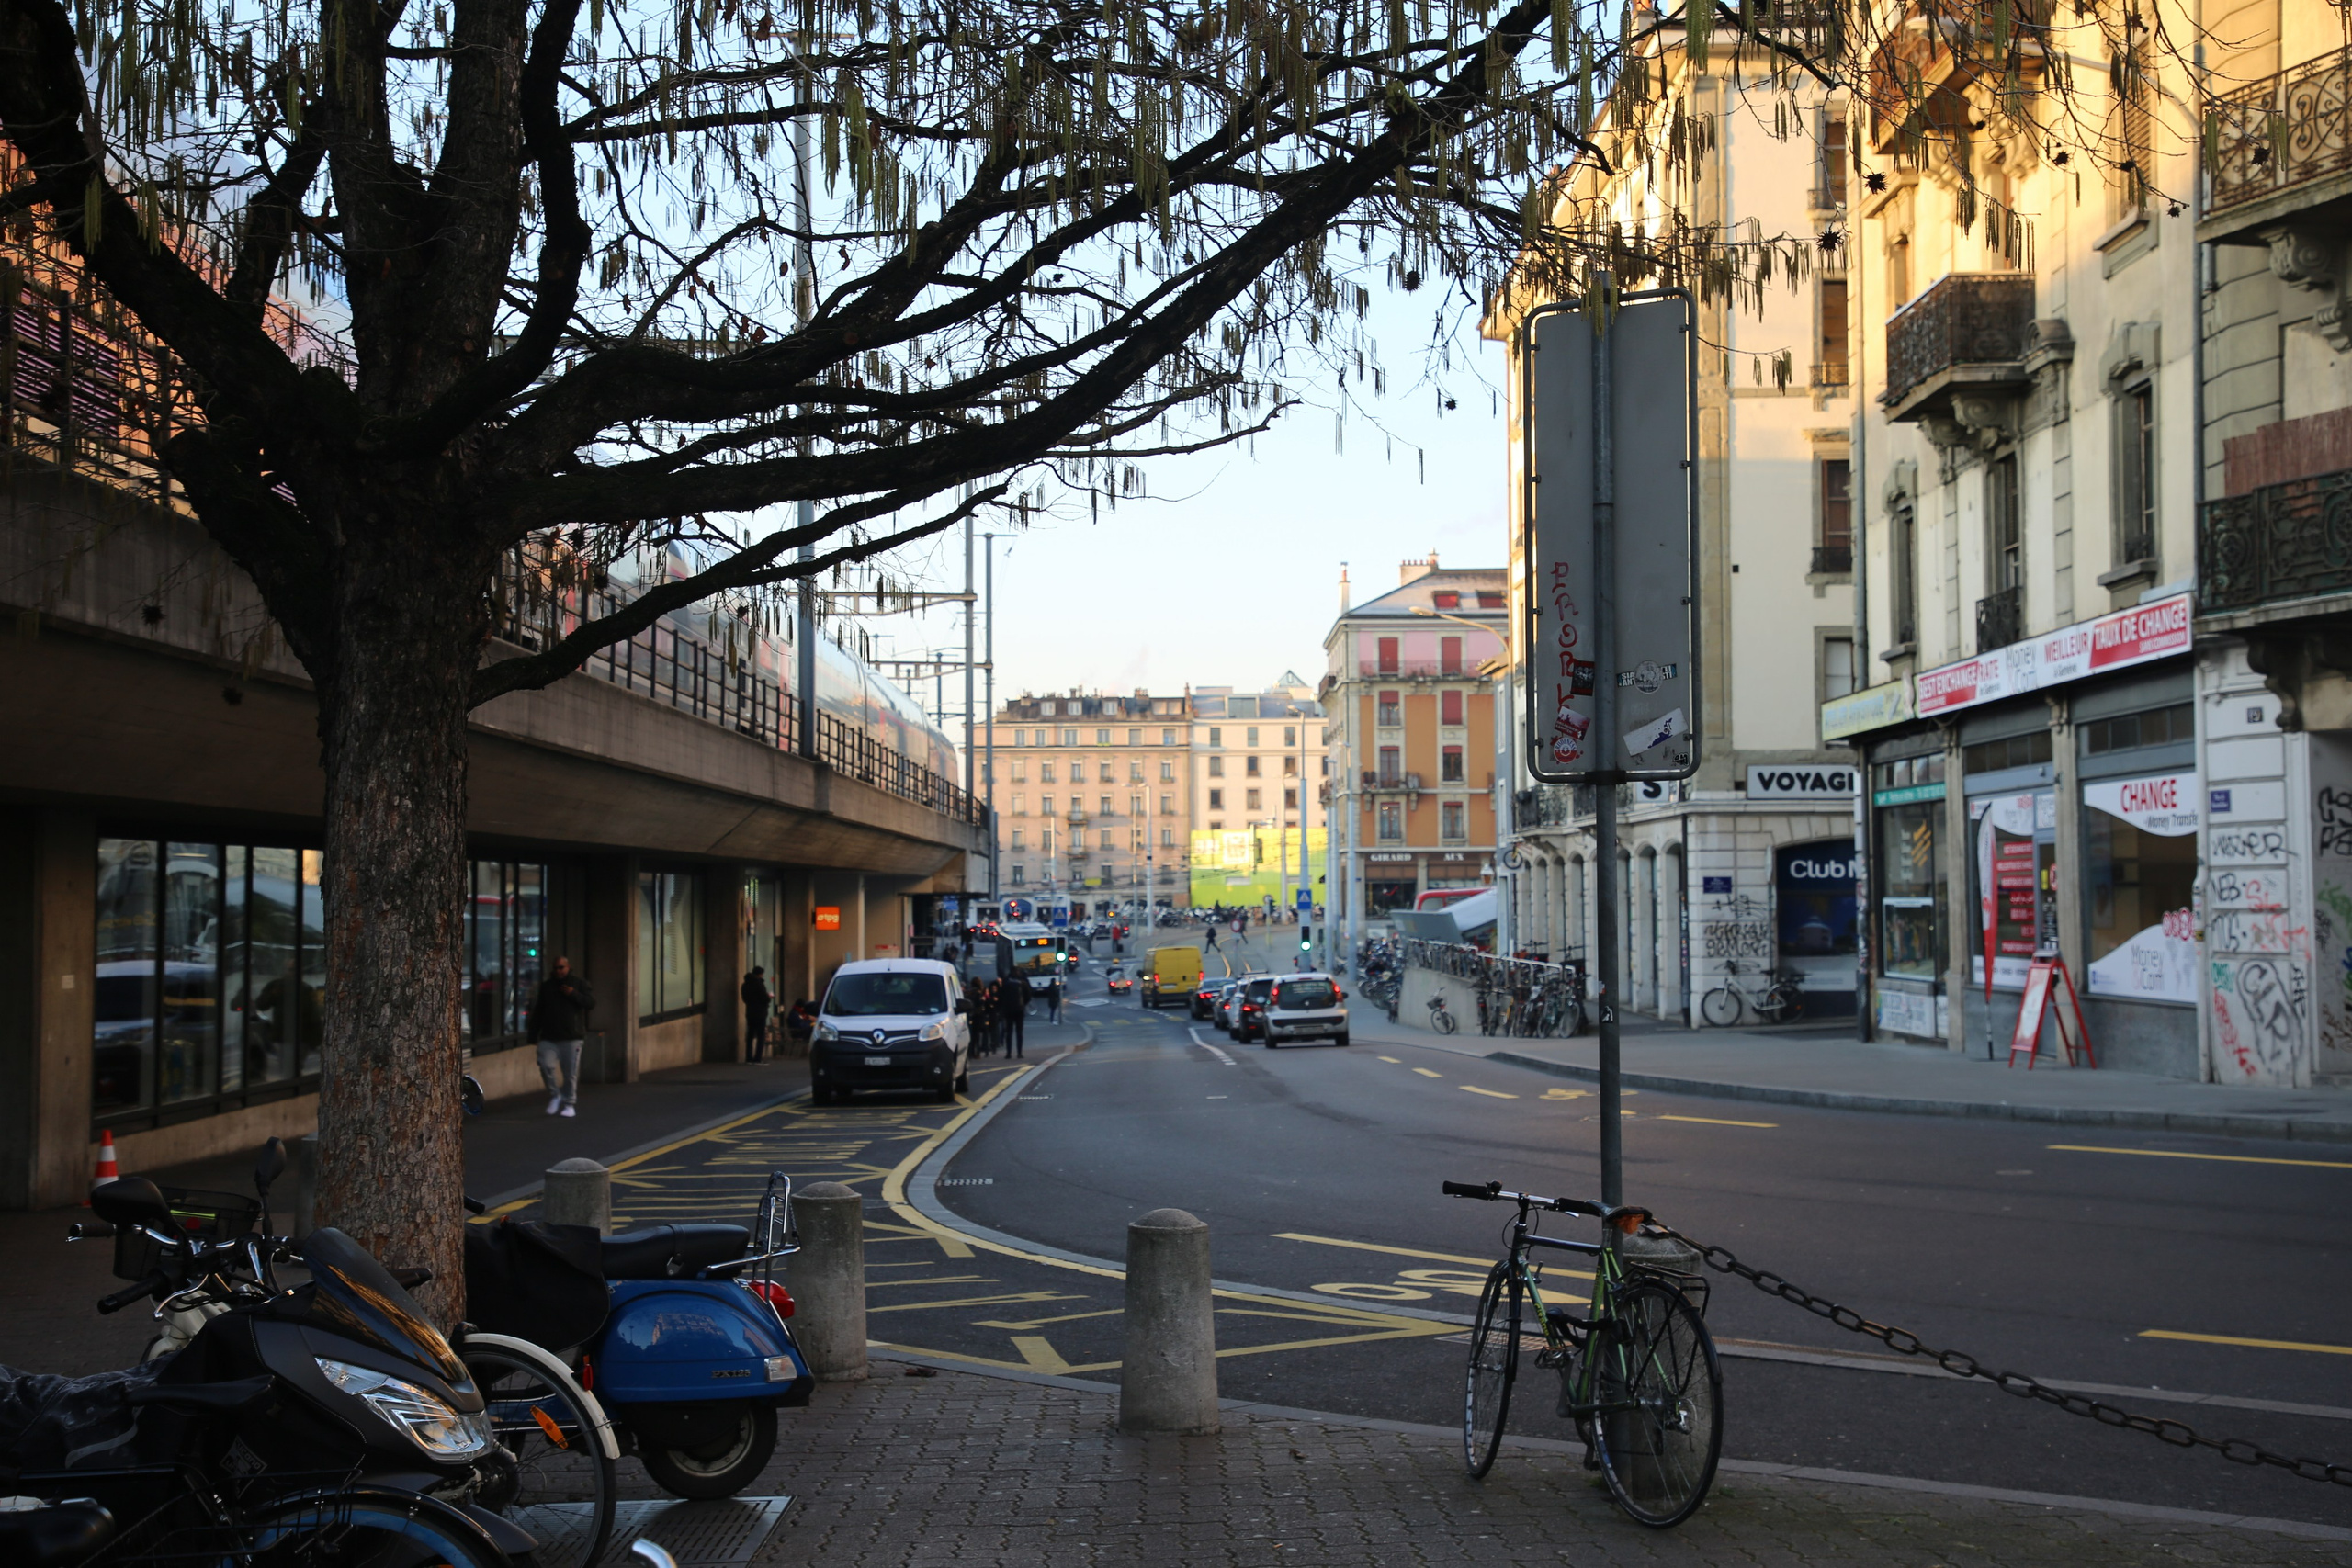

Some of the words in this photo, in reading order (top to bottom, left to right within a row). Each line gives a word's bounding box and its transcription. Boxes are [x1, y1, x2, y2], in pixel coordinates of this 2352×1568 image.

[2095, 622, 2121, 650] TAUX
[2122, 616, 2138, 643] DE
[2138, 603, 2186, 638] CHANGE
[1919, 678, 1935, 699] BEST
[1937, 665, 1977, 695] EXCHANGE
[1979, 659, 1999, 682] RATE
[2120, 779, 2177, 813] CHANGE
[1370, 853, 1412, 862] GIRARD
[1443, 853, 1464, 862] AUX
[1790, 860, 1845, 878] Club
